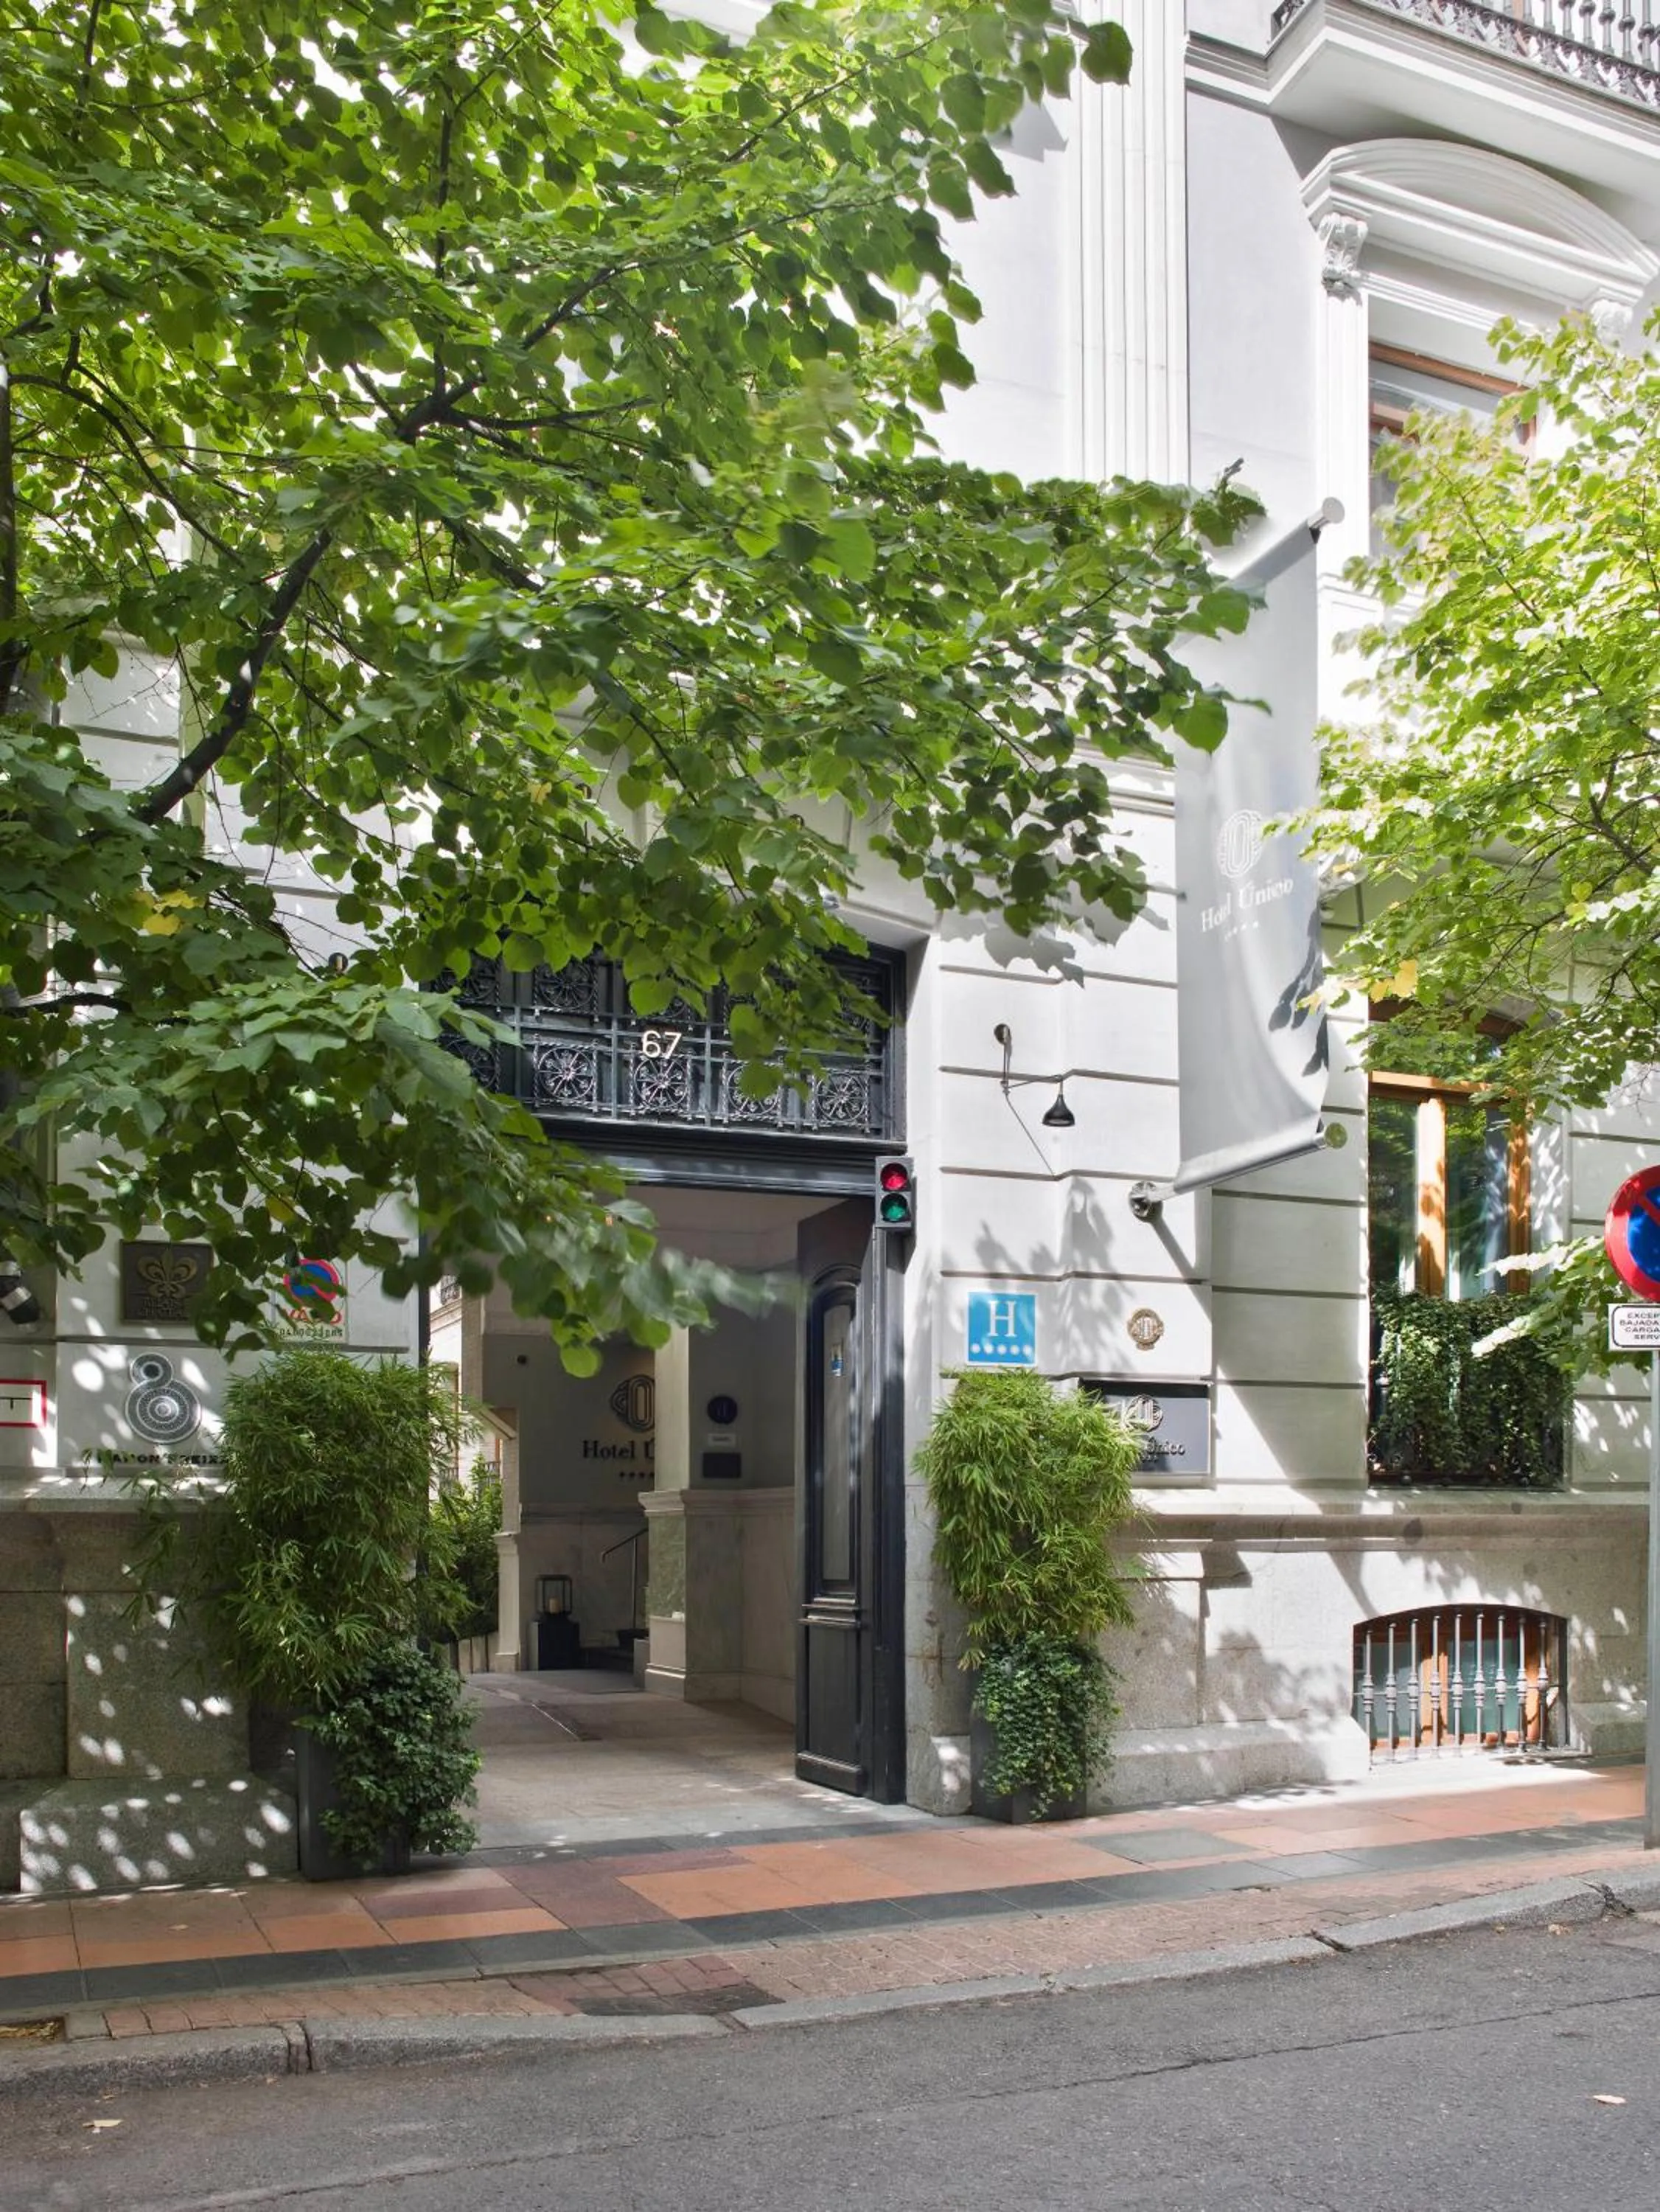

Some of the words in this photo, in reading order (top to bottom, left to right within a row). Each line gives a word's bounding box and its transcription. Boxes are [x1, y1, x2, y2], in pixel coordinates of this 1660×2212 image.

[641, 1029, 682, 1060] 67
[282, 1308, 342, 1324] VAO
[988, 1300, 1017, 1338] H
[102, 1453, 160, 1464] AON
[582, 1439, 636, 1459] Hotel
